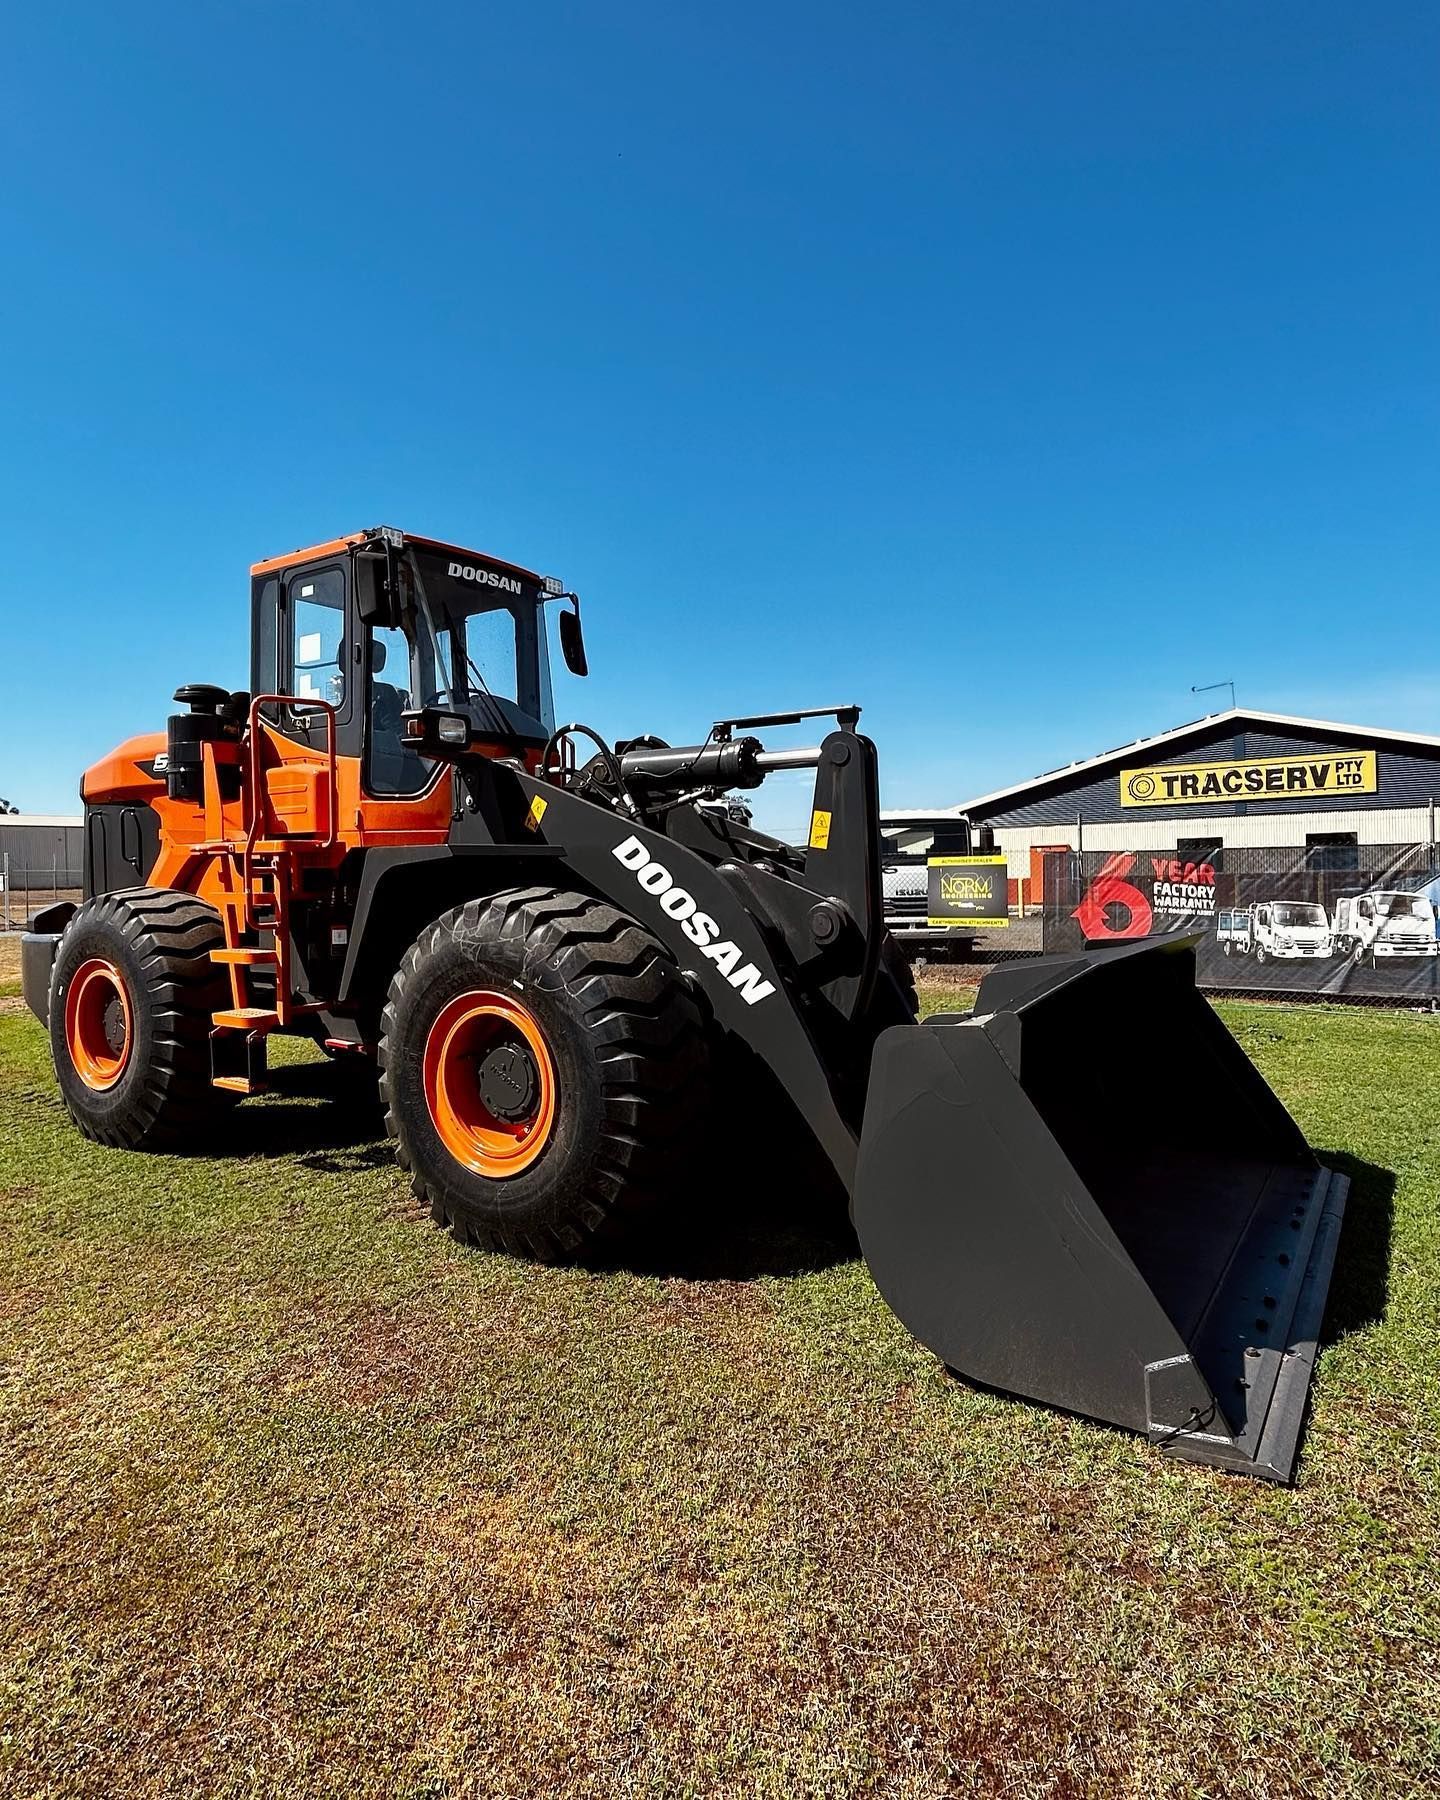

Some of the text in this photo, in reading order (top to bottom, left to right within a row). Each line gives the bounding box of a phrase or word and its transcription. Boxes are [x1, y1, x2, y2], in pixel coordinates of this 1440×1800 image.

[448, 562, 521, 594] DOOSAN
[1335, 760, 1364, 774] PTY
[1161, 763, 1331, 797] TRACSERV
[1336, 773, 1363, 786] LTD
[1151, 858, 1216, 885] YEAR
[895, 888, 929, 896] ISUZU
[941, 877, 988, 893] NORM
[1153, 881, 1216, 899] FACTORY
[1153, 895, 1216, 910] WARRANTY
[611, 834, 777, 1006] DOOSAN
